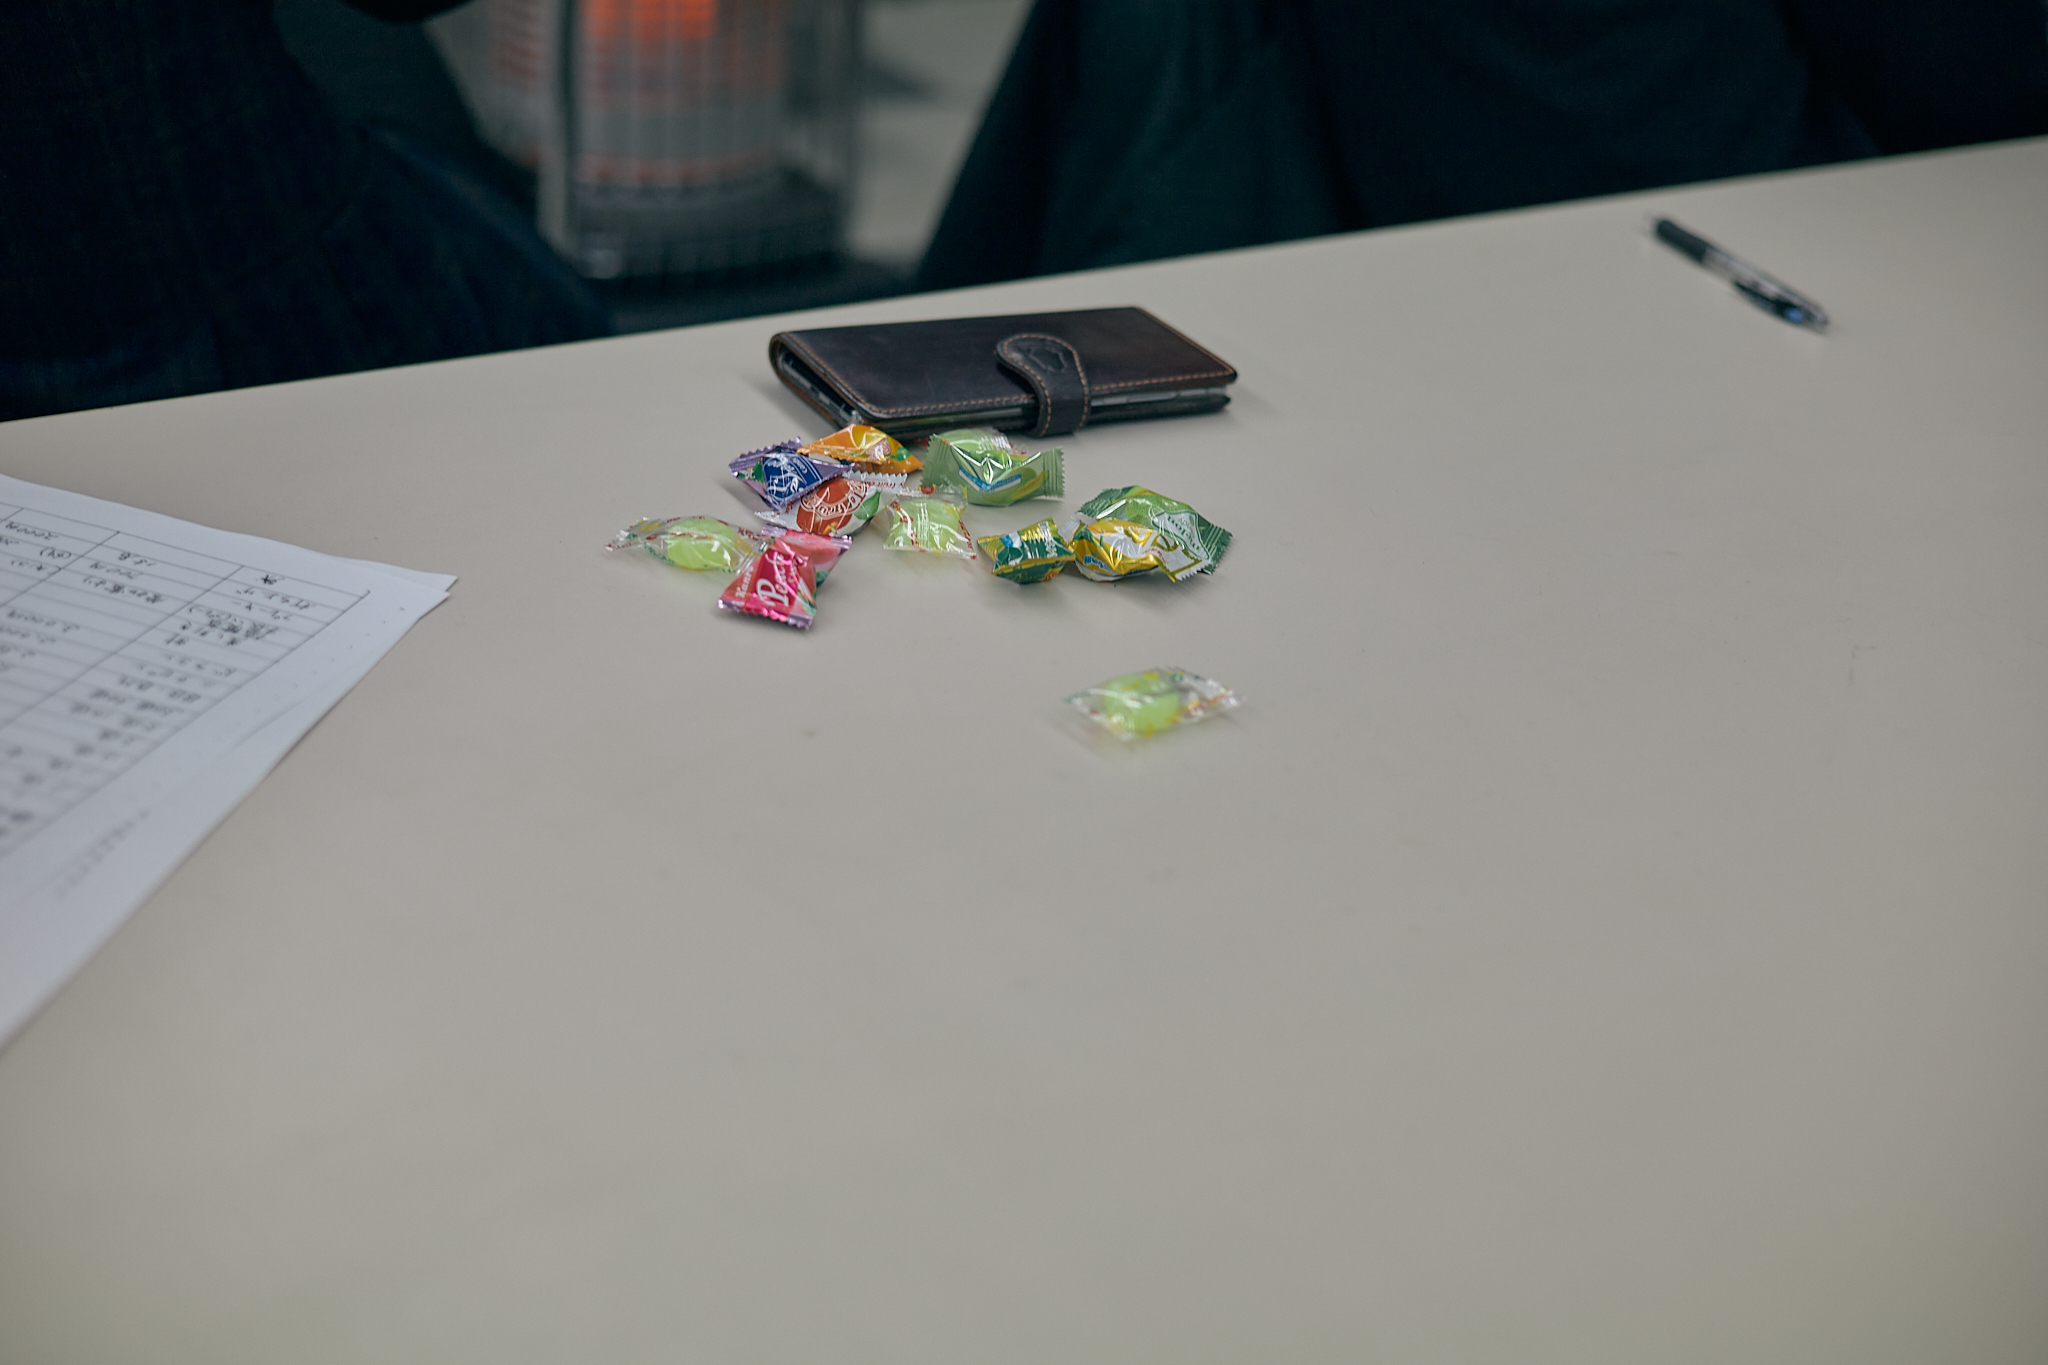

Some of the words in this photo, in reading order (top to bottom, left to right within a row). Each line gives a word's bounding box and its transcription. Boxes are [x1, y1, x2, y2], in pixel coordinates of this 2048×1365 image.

[1167, 515, 1201, 551] melon
[735, 566, 754, 598] Kanro
[756, 551, 792, 607] Peach
